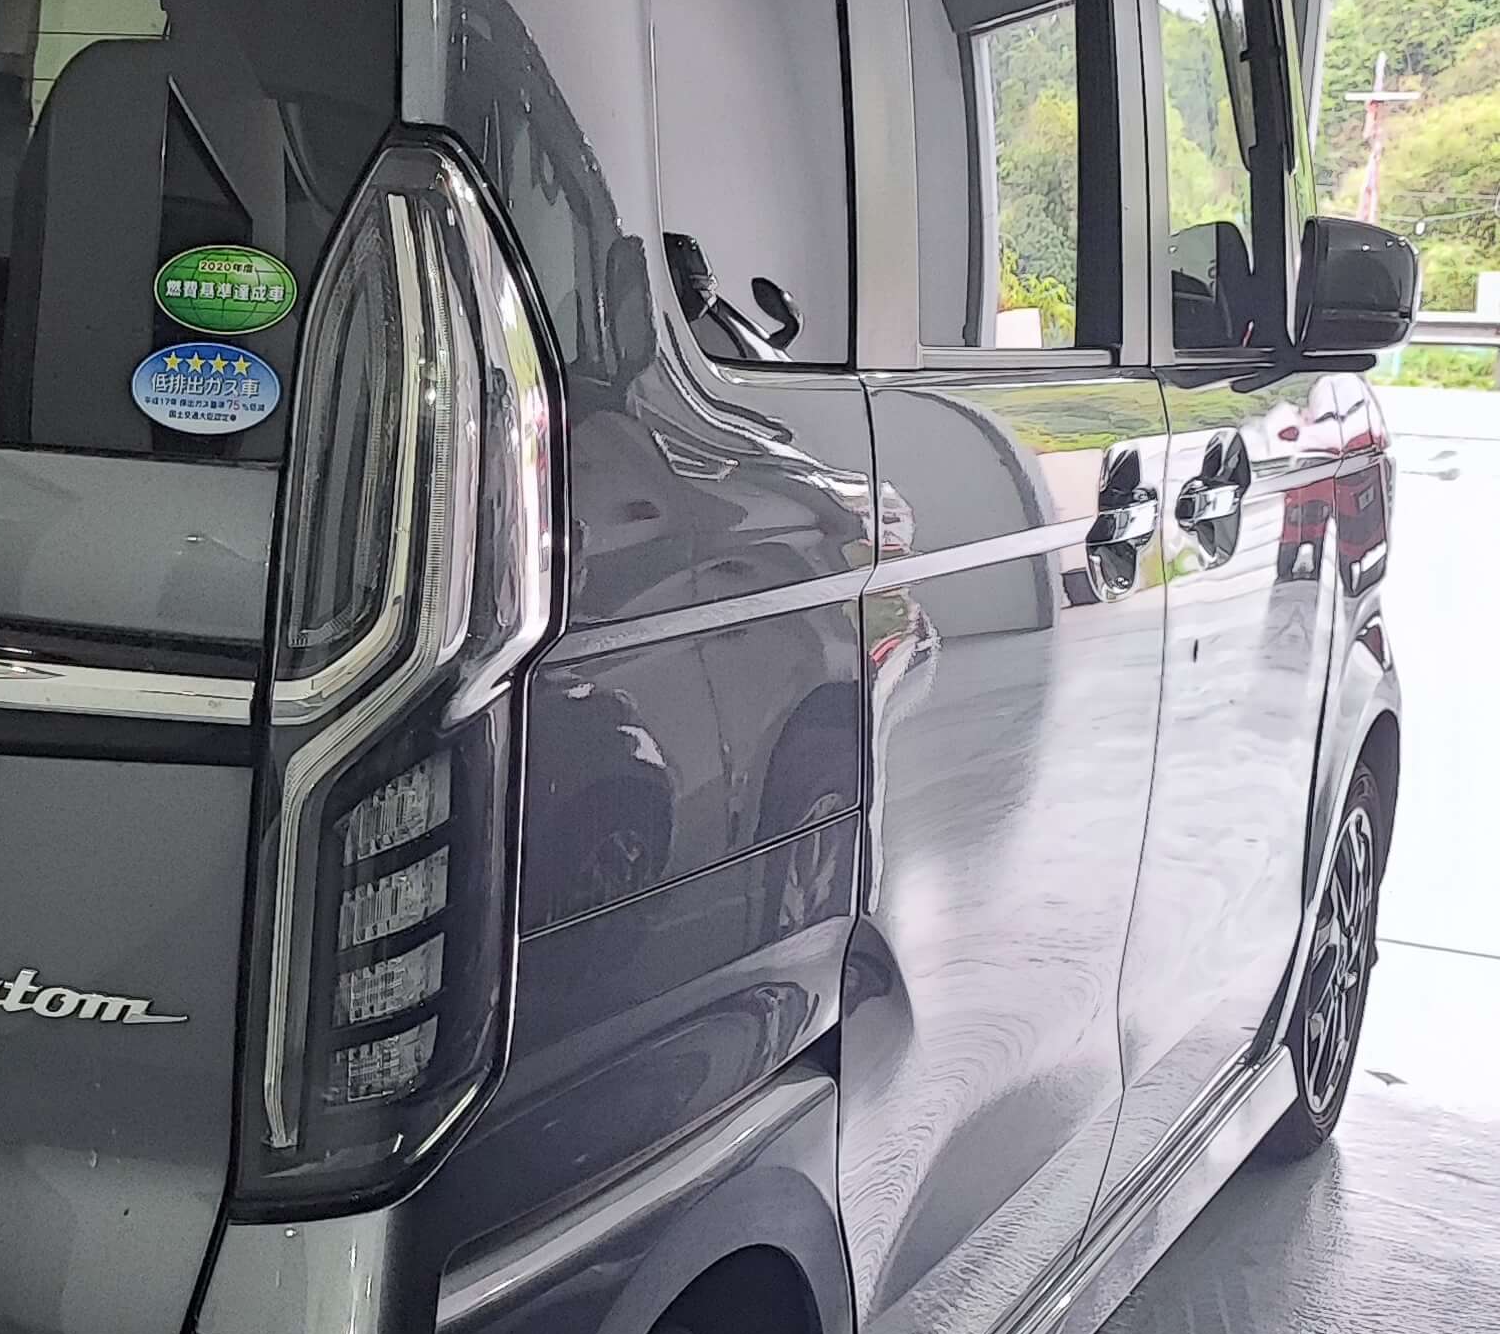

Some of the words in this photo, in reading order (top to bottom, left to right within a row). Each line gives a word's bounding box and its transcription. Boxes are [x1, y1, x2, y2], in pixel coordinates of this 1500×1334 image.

[152, 371, 261, 398] 低排出ガス車
